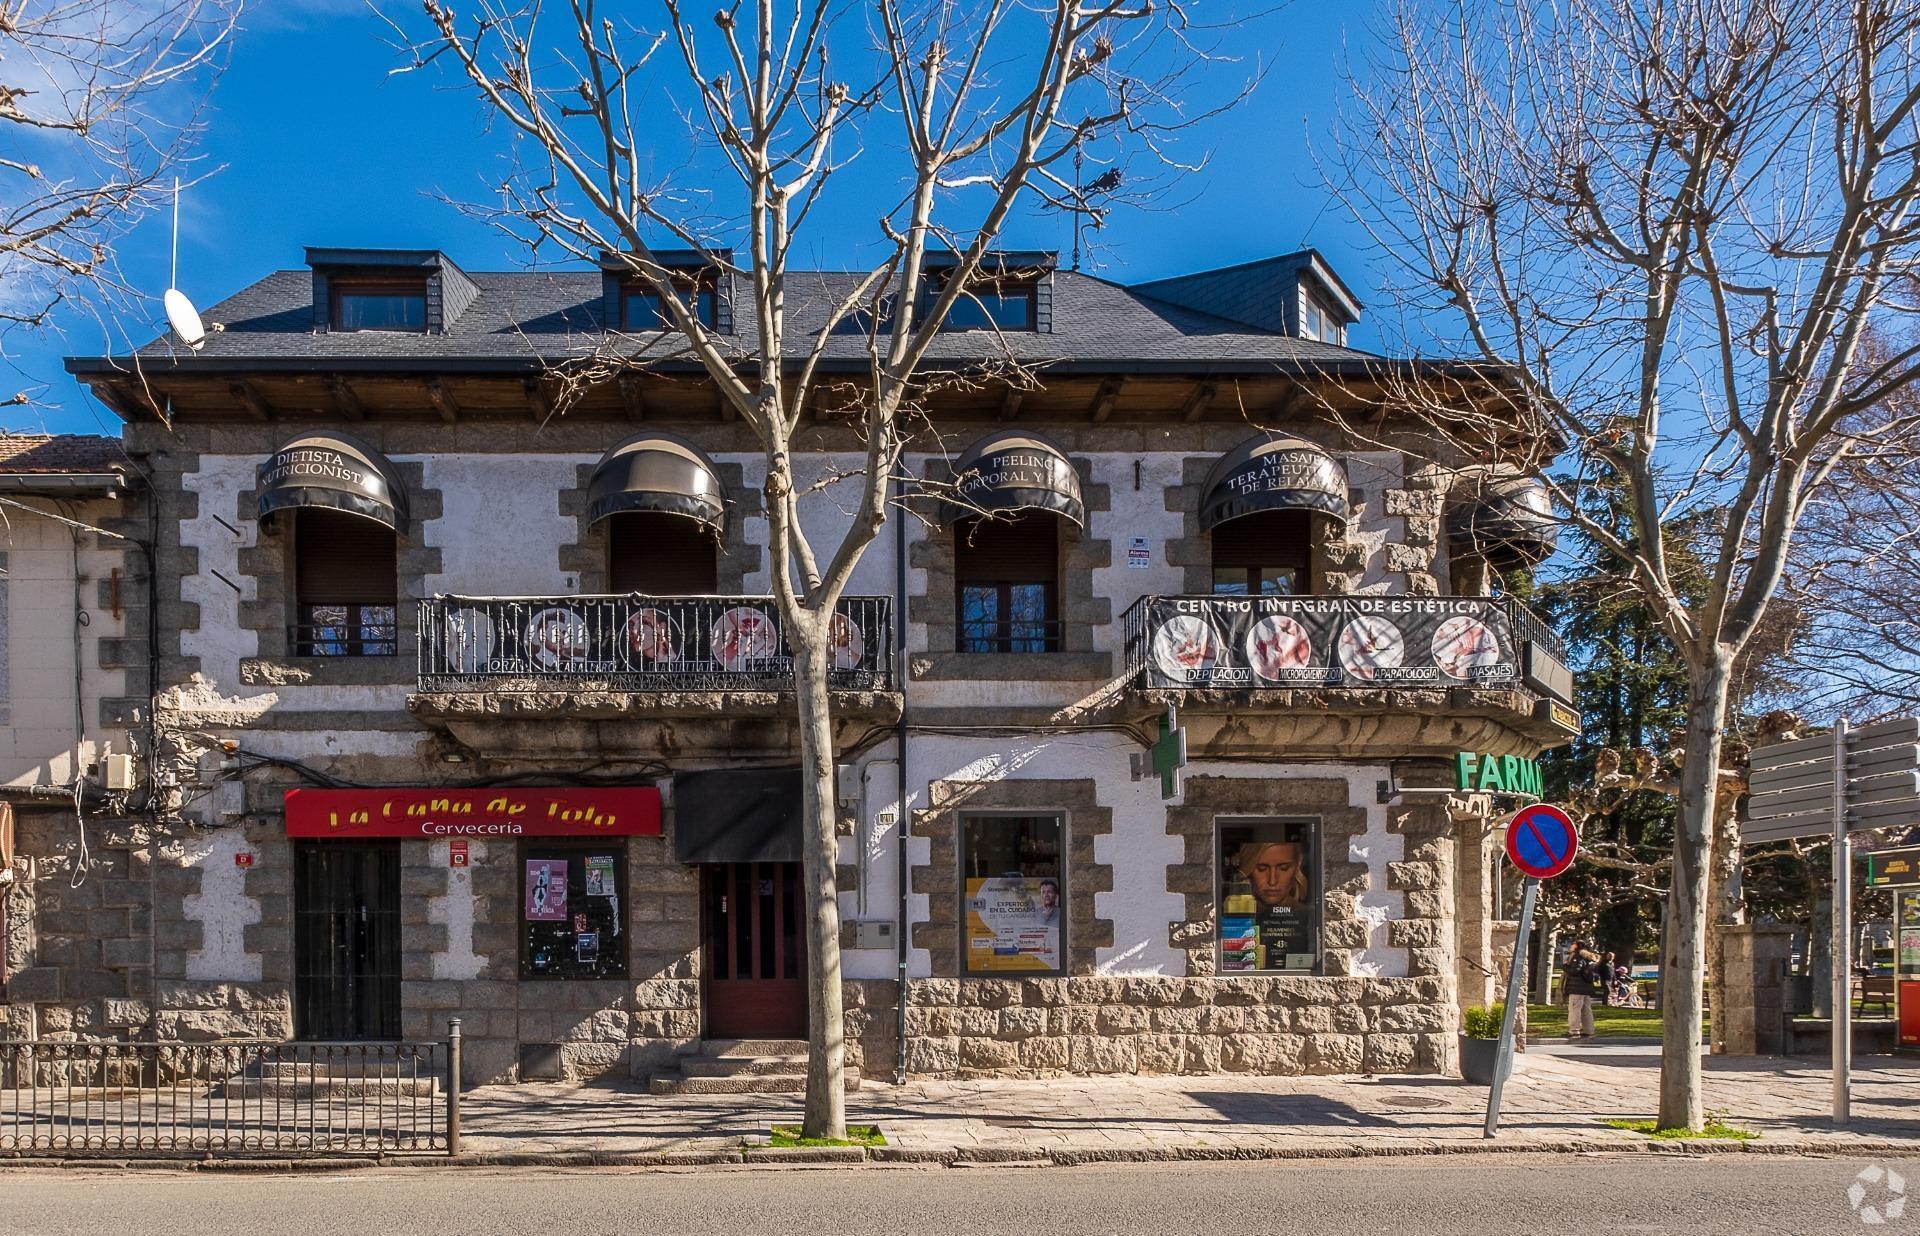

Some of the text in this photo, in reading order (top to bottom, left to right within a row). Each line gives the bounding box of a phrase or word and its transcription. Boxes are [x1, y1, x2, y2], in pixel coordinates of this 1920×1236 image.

[277, 450, 344, 467] DIETISTA
[262, 463, 371, 487] NUTRICIONISTA
[1034, 471, 1042, 483] Y
[1242, 480, 1261, 495] DE
[1176, 598, 1480, 613] CENTRO INTEGRAL DE ESTÉTICA
[1468, 665, 1512, 677] MASAJES
[329, 805, 370, 832] La
[484, 793, 527, 819] de
[543, 797, 617, 829] Tolo
[422, 821, 522, 835] Cervecería
